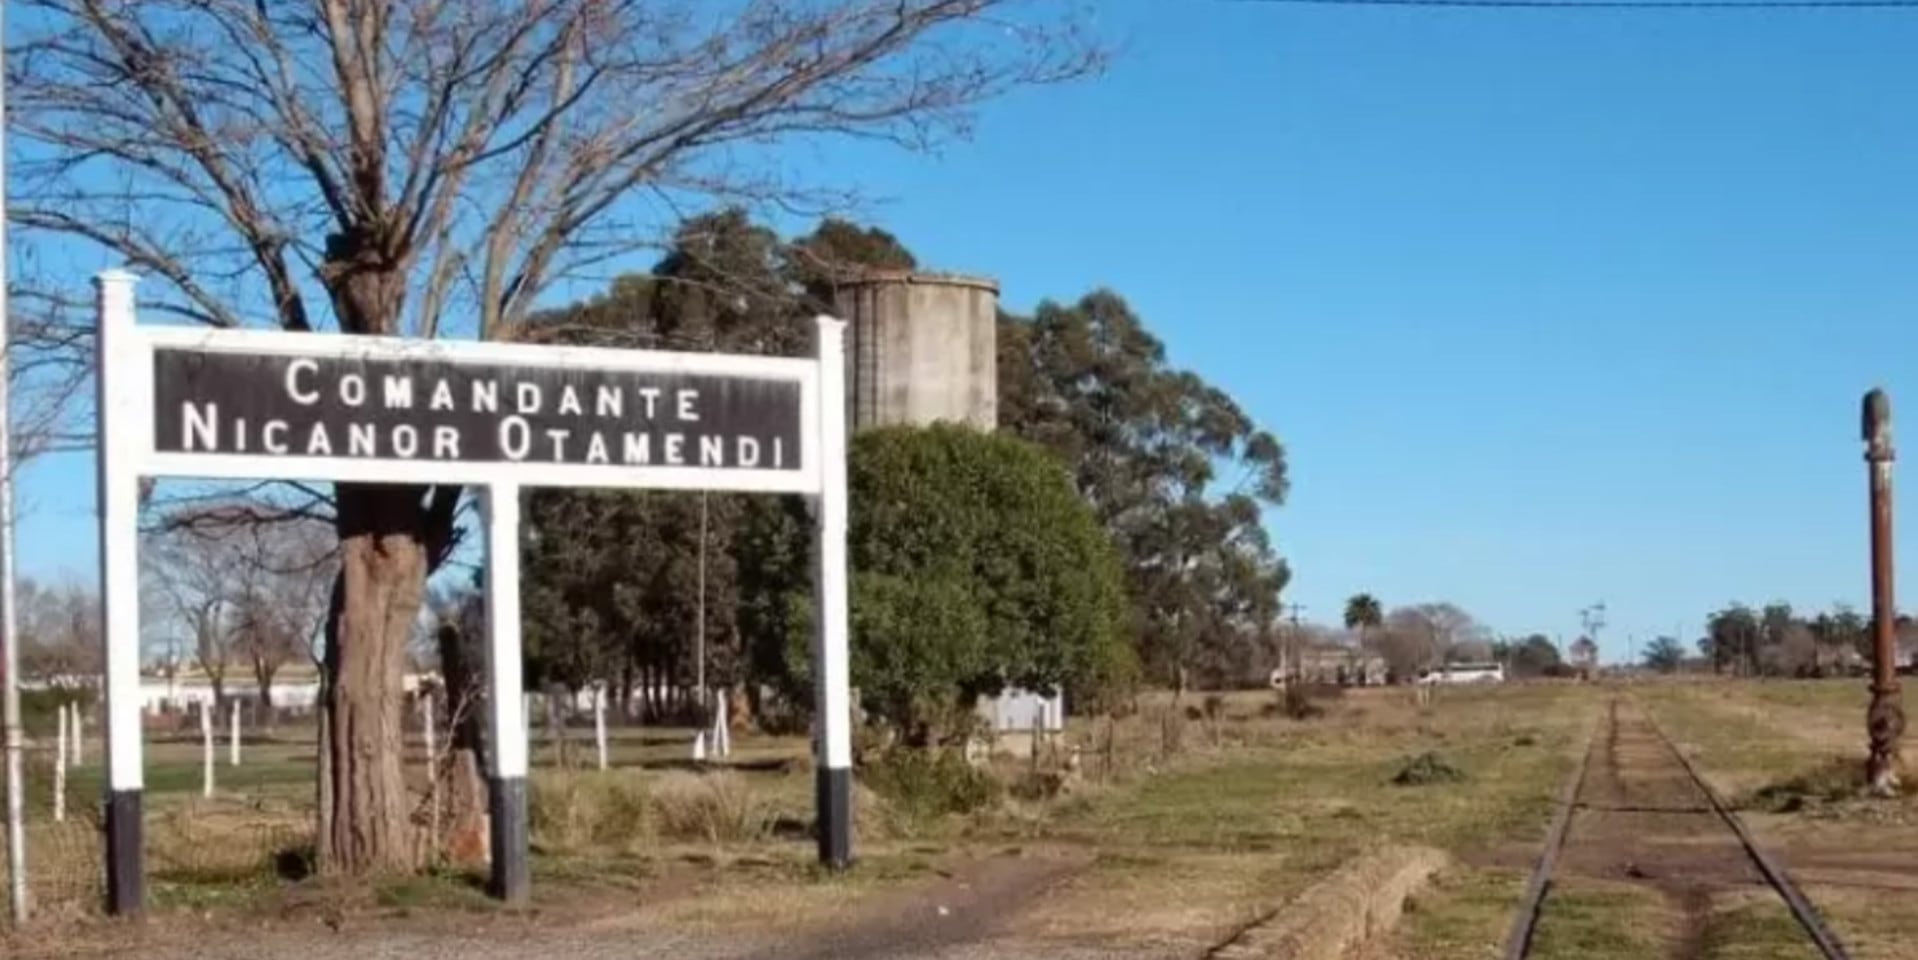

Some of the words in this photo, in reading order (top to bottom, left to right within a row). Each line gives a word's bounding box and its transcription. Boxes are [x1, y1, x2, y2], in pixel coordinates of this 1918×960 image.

[286, 358, 701, 421] COMANDANTE
[182, 402, 461, 458] NICANOR
[499, 415, 783, 468] OTAMENDI
